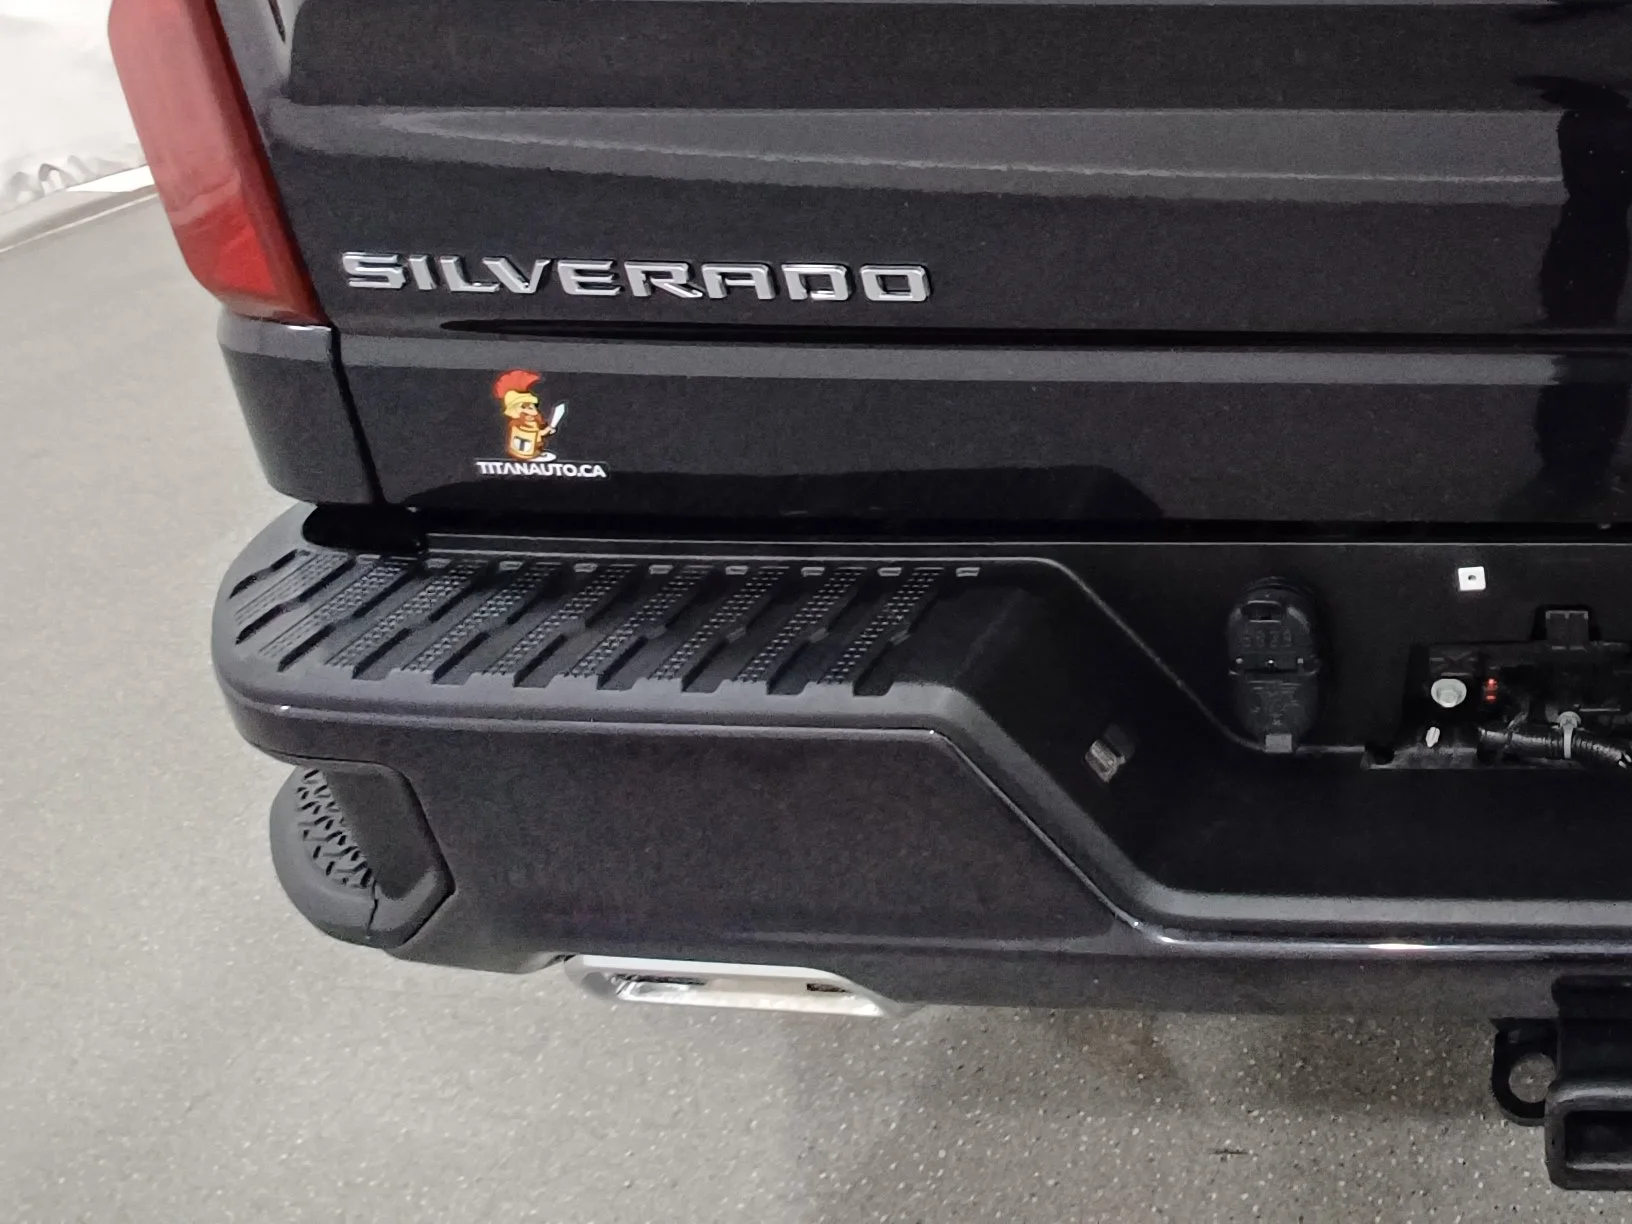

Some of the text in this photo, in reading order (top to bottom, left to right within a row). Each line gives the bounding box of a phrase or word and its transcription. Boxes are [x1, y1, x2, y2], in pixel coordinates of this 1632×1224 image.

[340, 251, 930, 303] SILVERADO
[513, 436, 531, 452] T
[476, 461, 607, 478] TITANAUTO.CA
